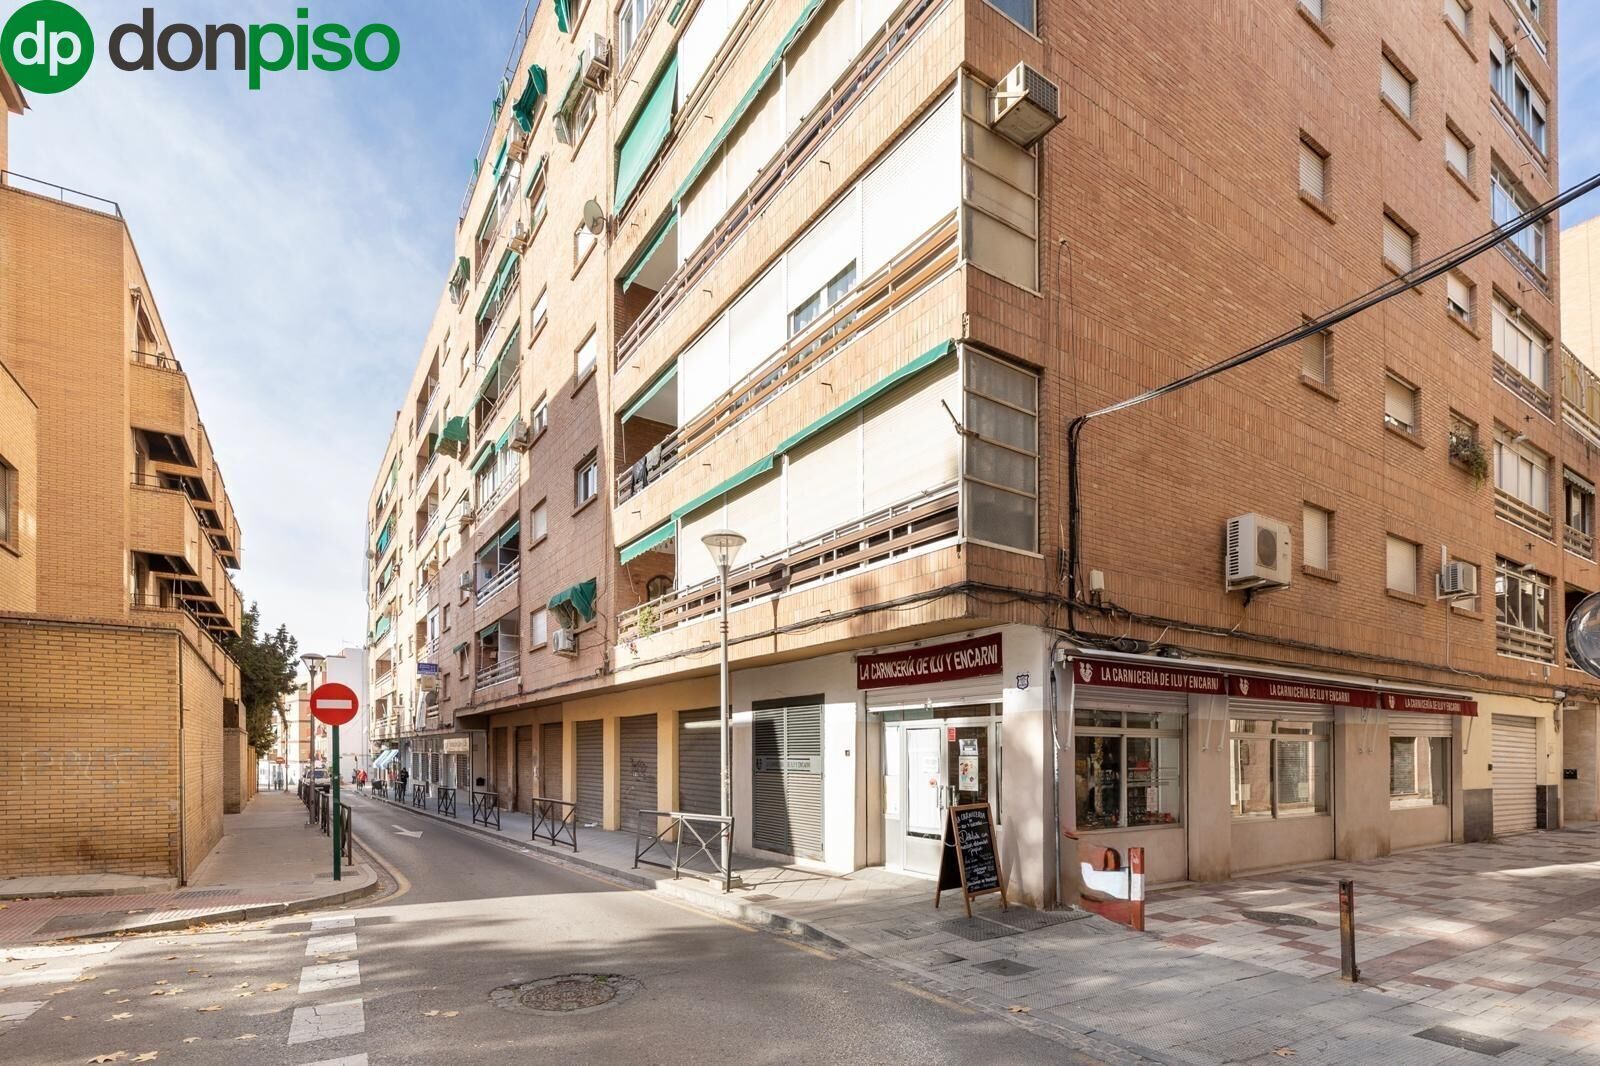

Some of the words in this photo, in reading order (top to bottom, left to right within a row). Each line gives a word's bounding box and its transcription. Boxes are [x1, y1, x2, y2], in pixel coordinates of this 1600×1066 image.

[860, 664, 870, 680] LA
[871, 656, 916, 680] CARNICERÍA
[916, 657, 928, 675] DE
[930, 654, 944, 673] ILU
[946, 653, 952, 671] Y
[954, 644, 998, 670] ENCARNI
[1101, 666, 1111, 680] LA
[1112, 668, 1159, 685] CARNICERÍA
[1160, 673, 1170, 686] DE
[1171, 674, 1182, 688] ILU
[1183, 674, 1188, 688] Y
[1189, 676, 1218, 690] ENCARNI
[1270, 683, 1277, 696] LA
[1277, 684, 1310, 699] CARNICERÍA
[1310, 688, 1316, 700] DE
[1324, 689, 1329, 701] Y
[1329, 690, 1350, 703] ENCARNI
